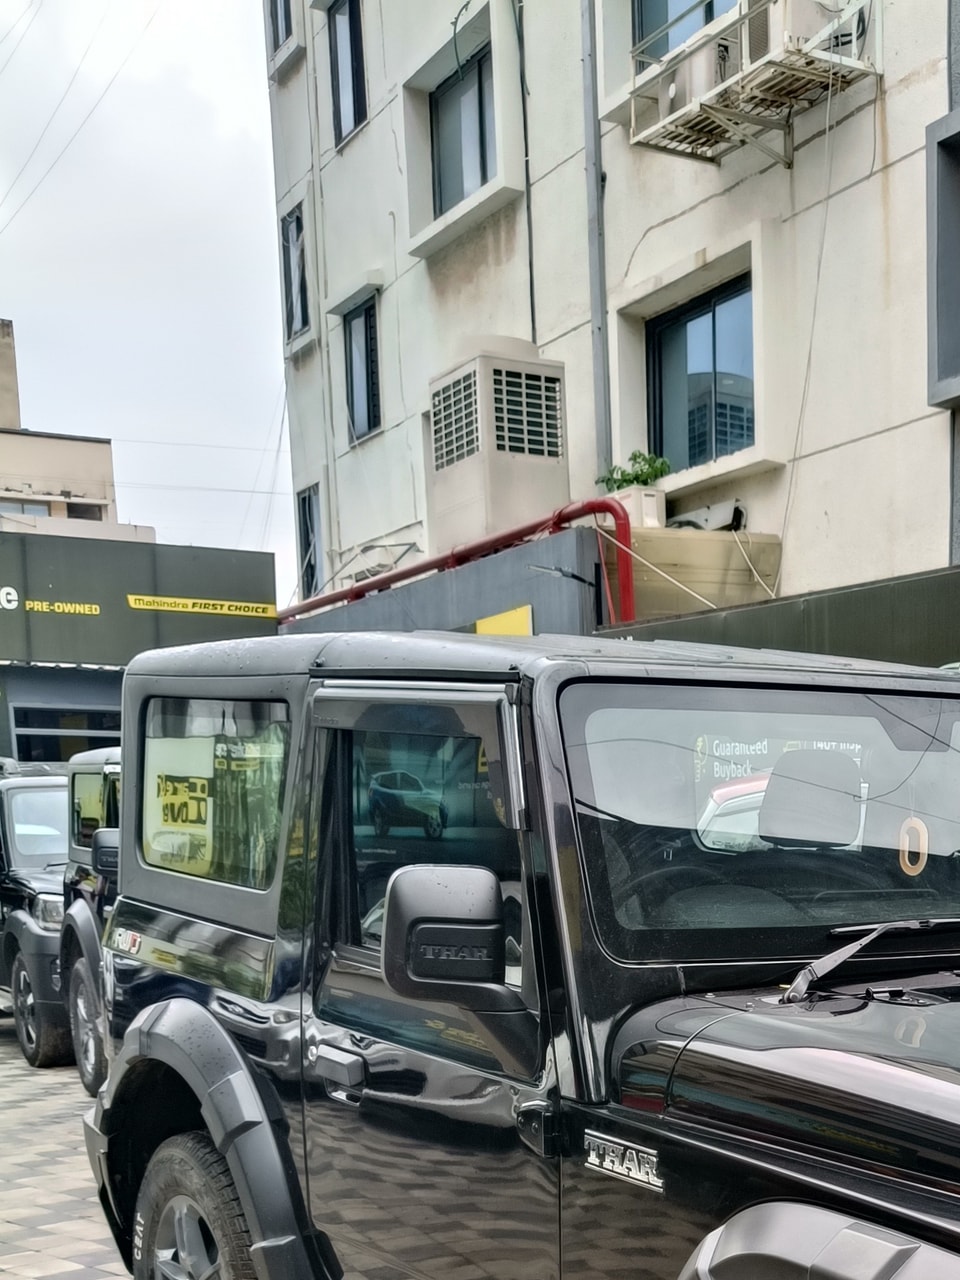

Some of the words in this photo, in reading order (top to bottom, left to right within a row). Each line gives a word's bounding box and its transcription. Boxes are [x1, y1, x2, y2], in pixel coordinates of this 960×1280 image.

[25, 601, 100, 615] PRE-OWNED
[134, 597, 189, 610] Mahindra
[191, 601, 225, 612] FIRST
[228, 604, 268, 614] CHOICE
[713, 738, 768, 757] Guaranteed
[713, 758, 752, 781] Buyback
[584, 1130, 664, 1190] THAR
[134, 1213, 146, 1261] CEAT
